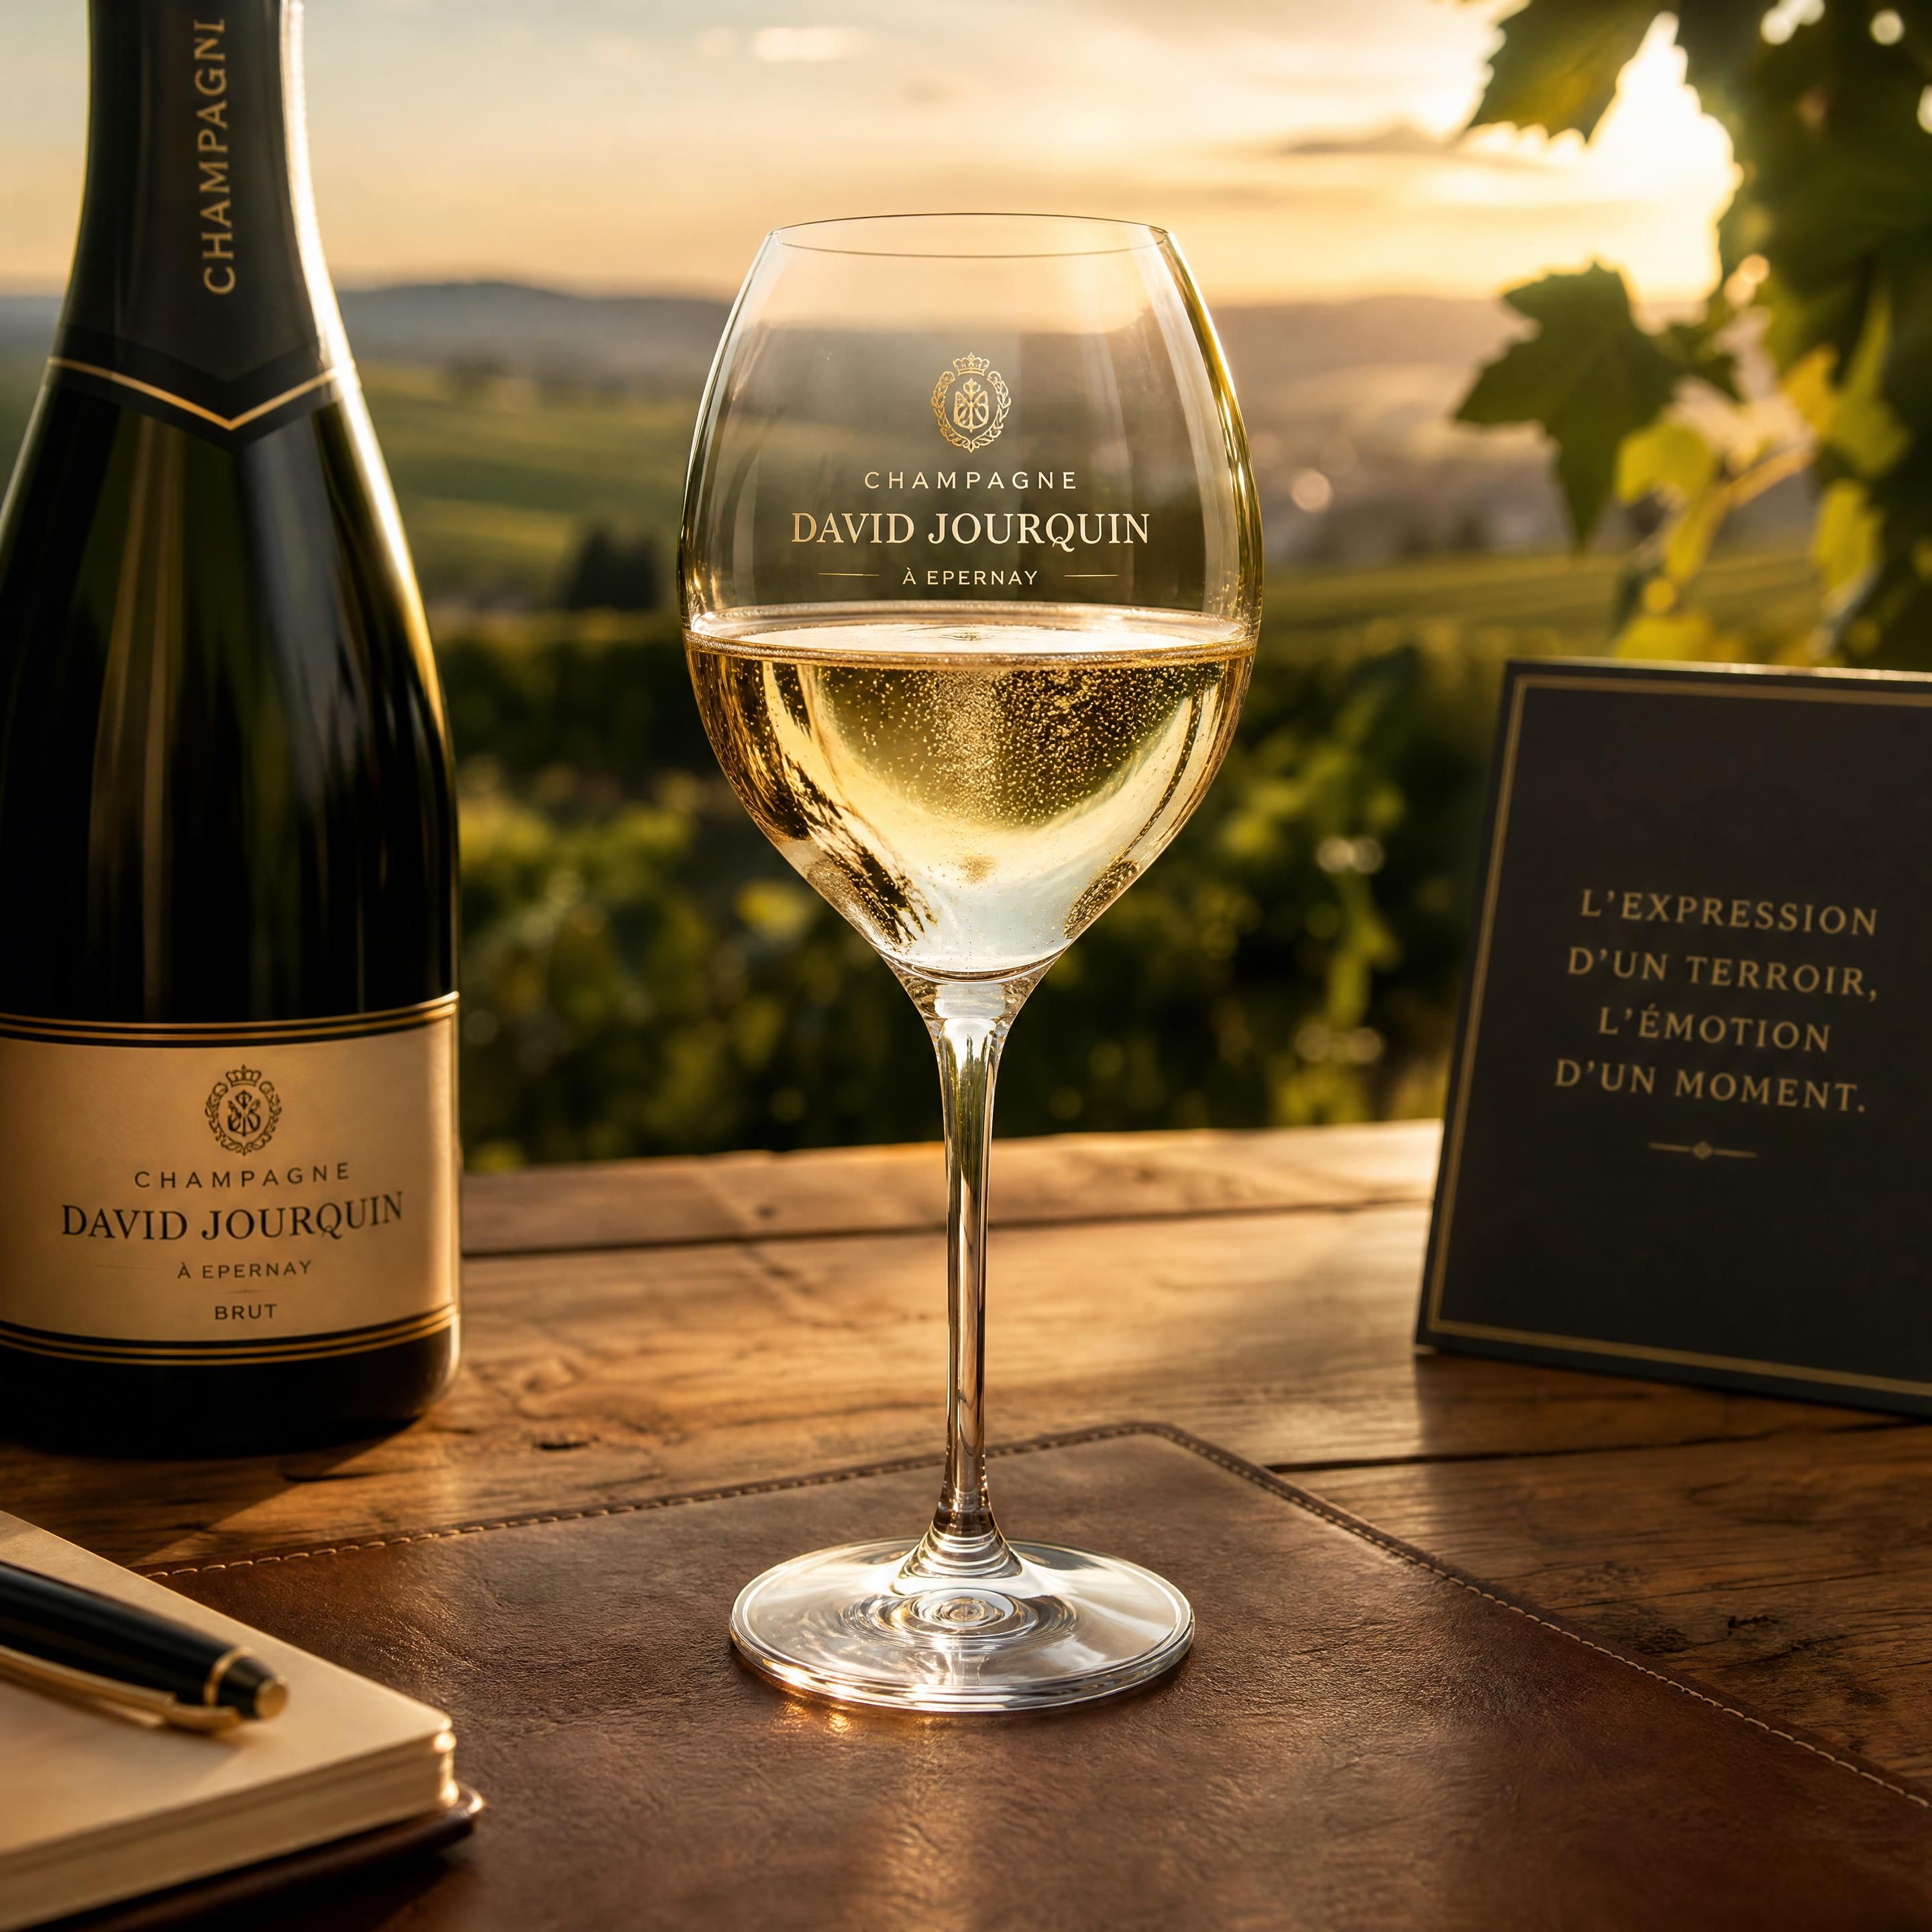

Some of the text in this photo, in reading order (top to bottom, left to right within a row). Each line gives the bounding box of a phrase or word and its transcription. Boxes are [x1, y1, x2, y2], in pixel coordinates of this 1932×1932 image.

[864, 471, 1077, 490] CHAMPAGNE
[792, 512, 1150, 553] DAVID JOURQUIN
[902, 566, 1038, 586] À EPERNAY
[1580, 889, 1878, 936] L’EXPRESSION
[1568, 947, 1878, 1002] D’UN TERROIR,
[1598, 1003, 1831, 1053] L’ÉMOTION
[1554, 1059, 1866, 1113] D’UN MOMENT.
[134, 1162, 350, 1189] CHAMPAGNE
[62, 1191, 404, 1240] DAVID JOURQUIN
[177, 1259, 312, 1279] À EPERNAY
[214, 1303, 278, 1322] BRUT
